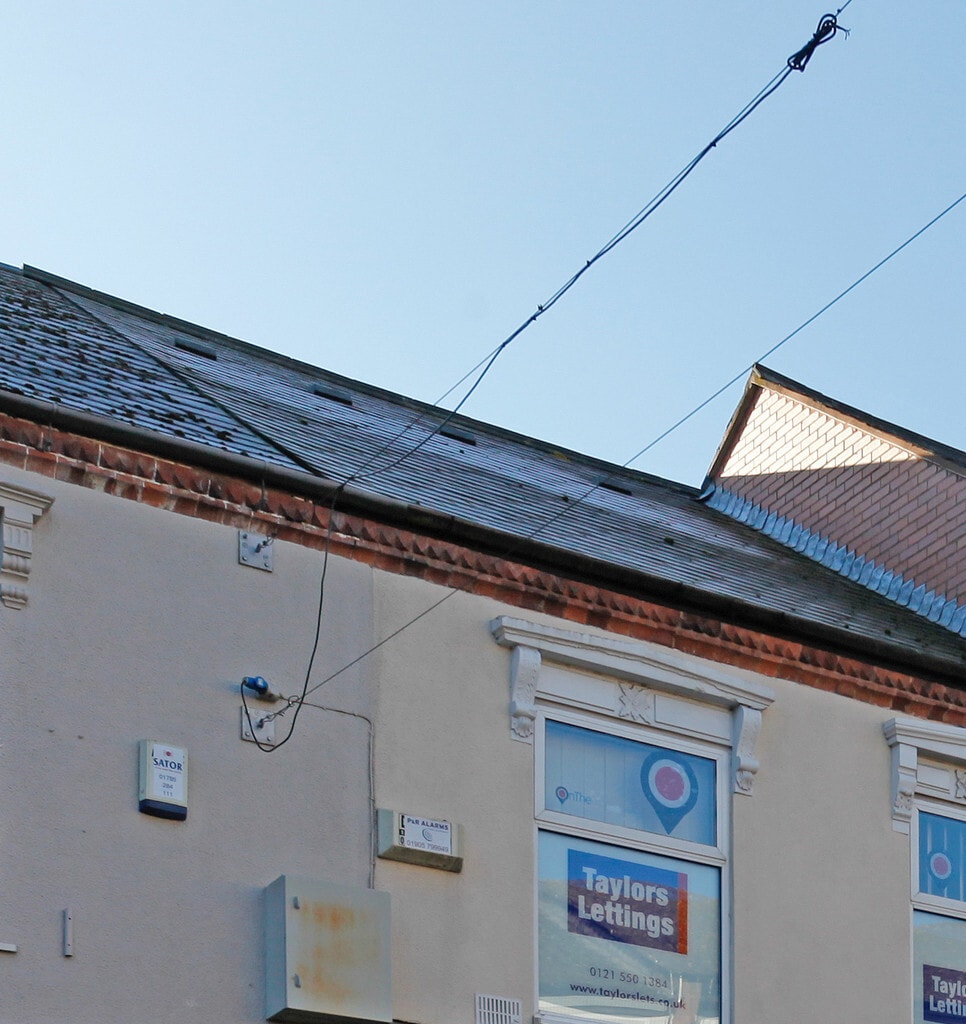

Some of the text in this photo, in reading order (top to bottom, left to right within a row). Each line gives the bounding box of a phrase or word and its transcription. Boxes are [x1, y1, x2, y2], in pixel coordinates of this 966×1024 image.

[153, 758, 183, 771] SATOR
[421, 820, 448, 831] ALARMS
[582, 866, 669, 906] Taylors
[578, 895, 674, 938] Lettings
[590, 966, 668, 989] 0121 550 1384
